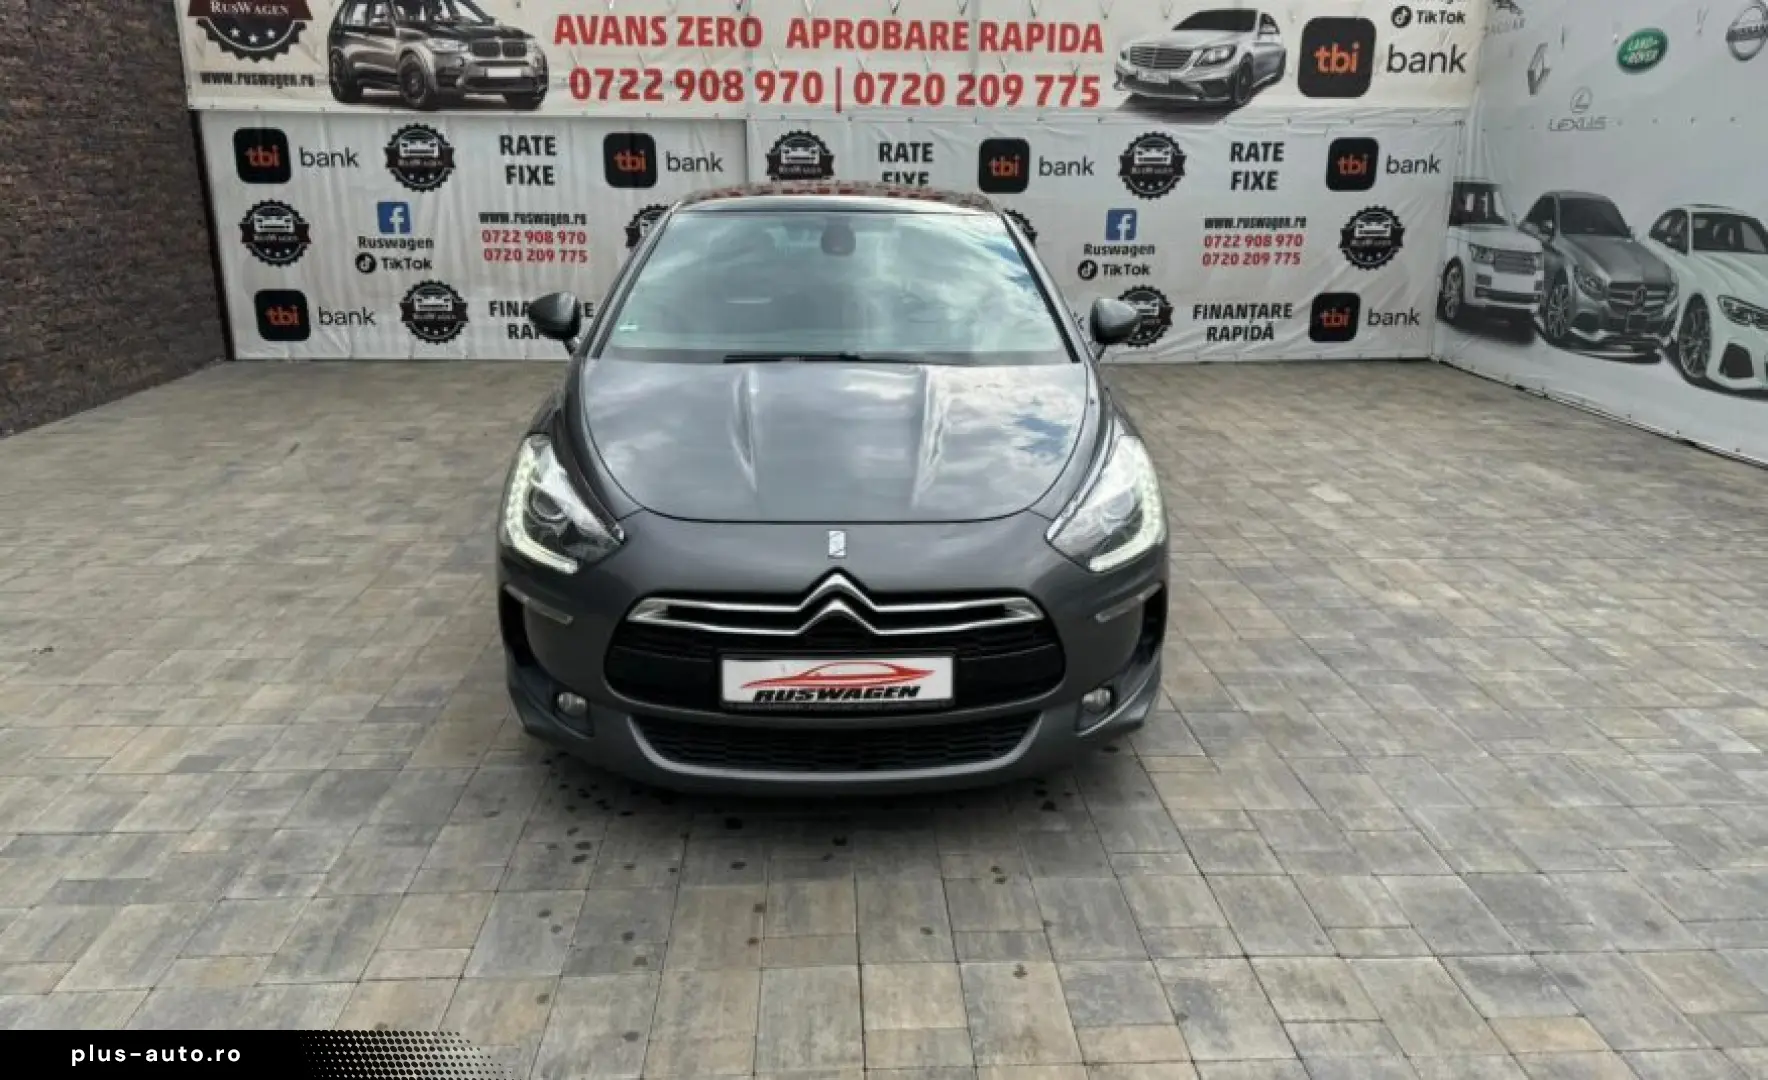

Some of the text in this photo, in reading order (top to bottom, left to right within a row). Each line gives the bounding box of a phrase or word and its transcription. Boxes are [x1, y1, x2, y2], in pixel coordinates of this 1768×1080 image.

[1417, 9, 1466, 24] TikTok
[553, 15, 1104, 54] AVANS ZERO APROBARE RAPIDA
[1315, 43, 1468, 75] tbi bank
[200, 72, 316, 89] www.ruswagen.ro
[569, 67, 664, 101] 0722
[674, 68, 745, 102] 908
[754, 70, 823, 104] 970
[853, 72, 946, 106] 0720
[956, 73, 1024, 107] 209
[1034, 74, 1101, 108] 775
[500, 134, 558, 157] RATE
[878, 141, 934, 163] RATE
[1230, 141, 1285, 163] RATE
[245, 144, 359, 169] tbi bank
[614, 150, 723, 173] tbi bank
[989, 155, 1095, 177] tbi bank
[1337, 153, 1442, 177] tbi bank
[505, 164, 557, 187] FIXE
[1230, 171, 1278, 192] FIXE
[358, 235, 435, 252] Ruswagen
[482, 229, 587, 246] 0722 908 970
[1204, 234, 1304, 249] 0722 908 970
[483, 248, 588, 264] 0720 209 775
[1083, 243, 1156, 258] Ruswagen
[1202, 252, 1302, 266] 0720 209 775
[381, 257, 433, 271] TikTok
[1102, 262, 1151, 277] TikTok
[265, 305, 377, 326] tbi bank
[1320, 307, 1421, 328] tbi bank
[1206, 321, 1274, 342] RAPIDĂ
[752, 685, 921, 703] RUSWAGEN
